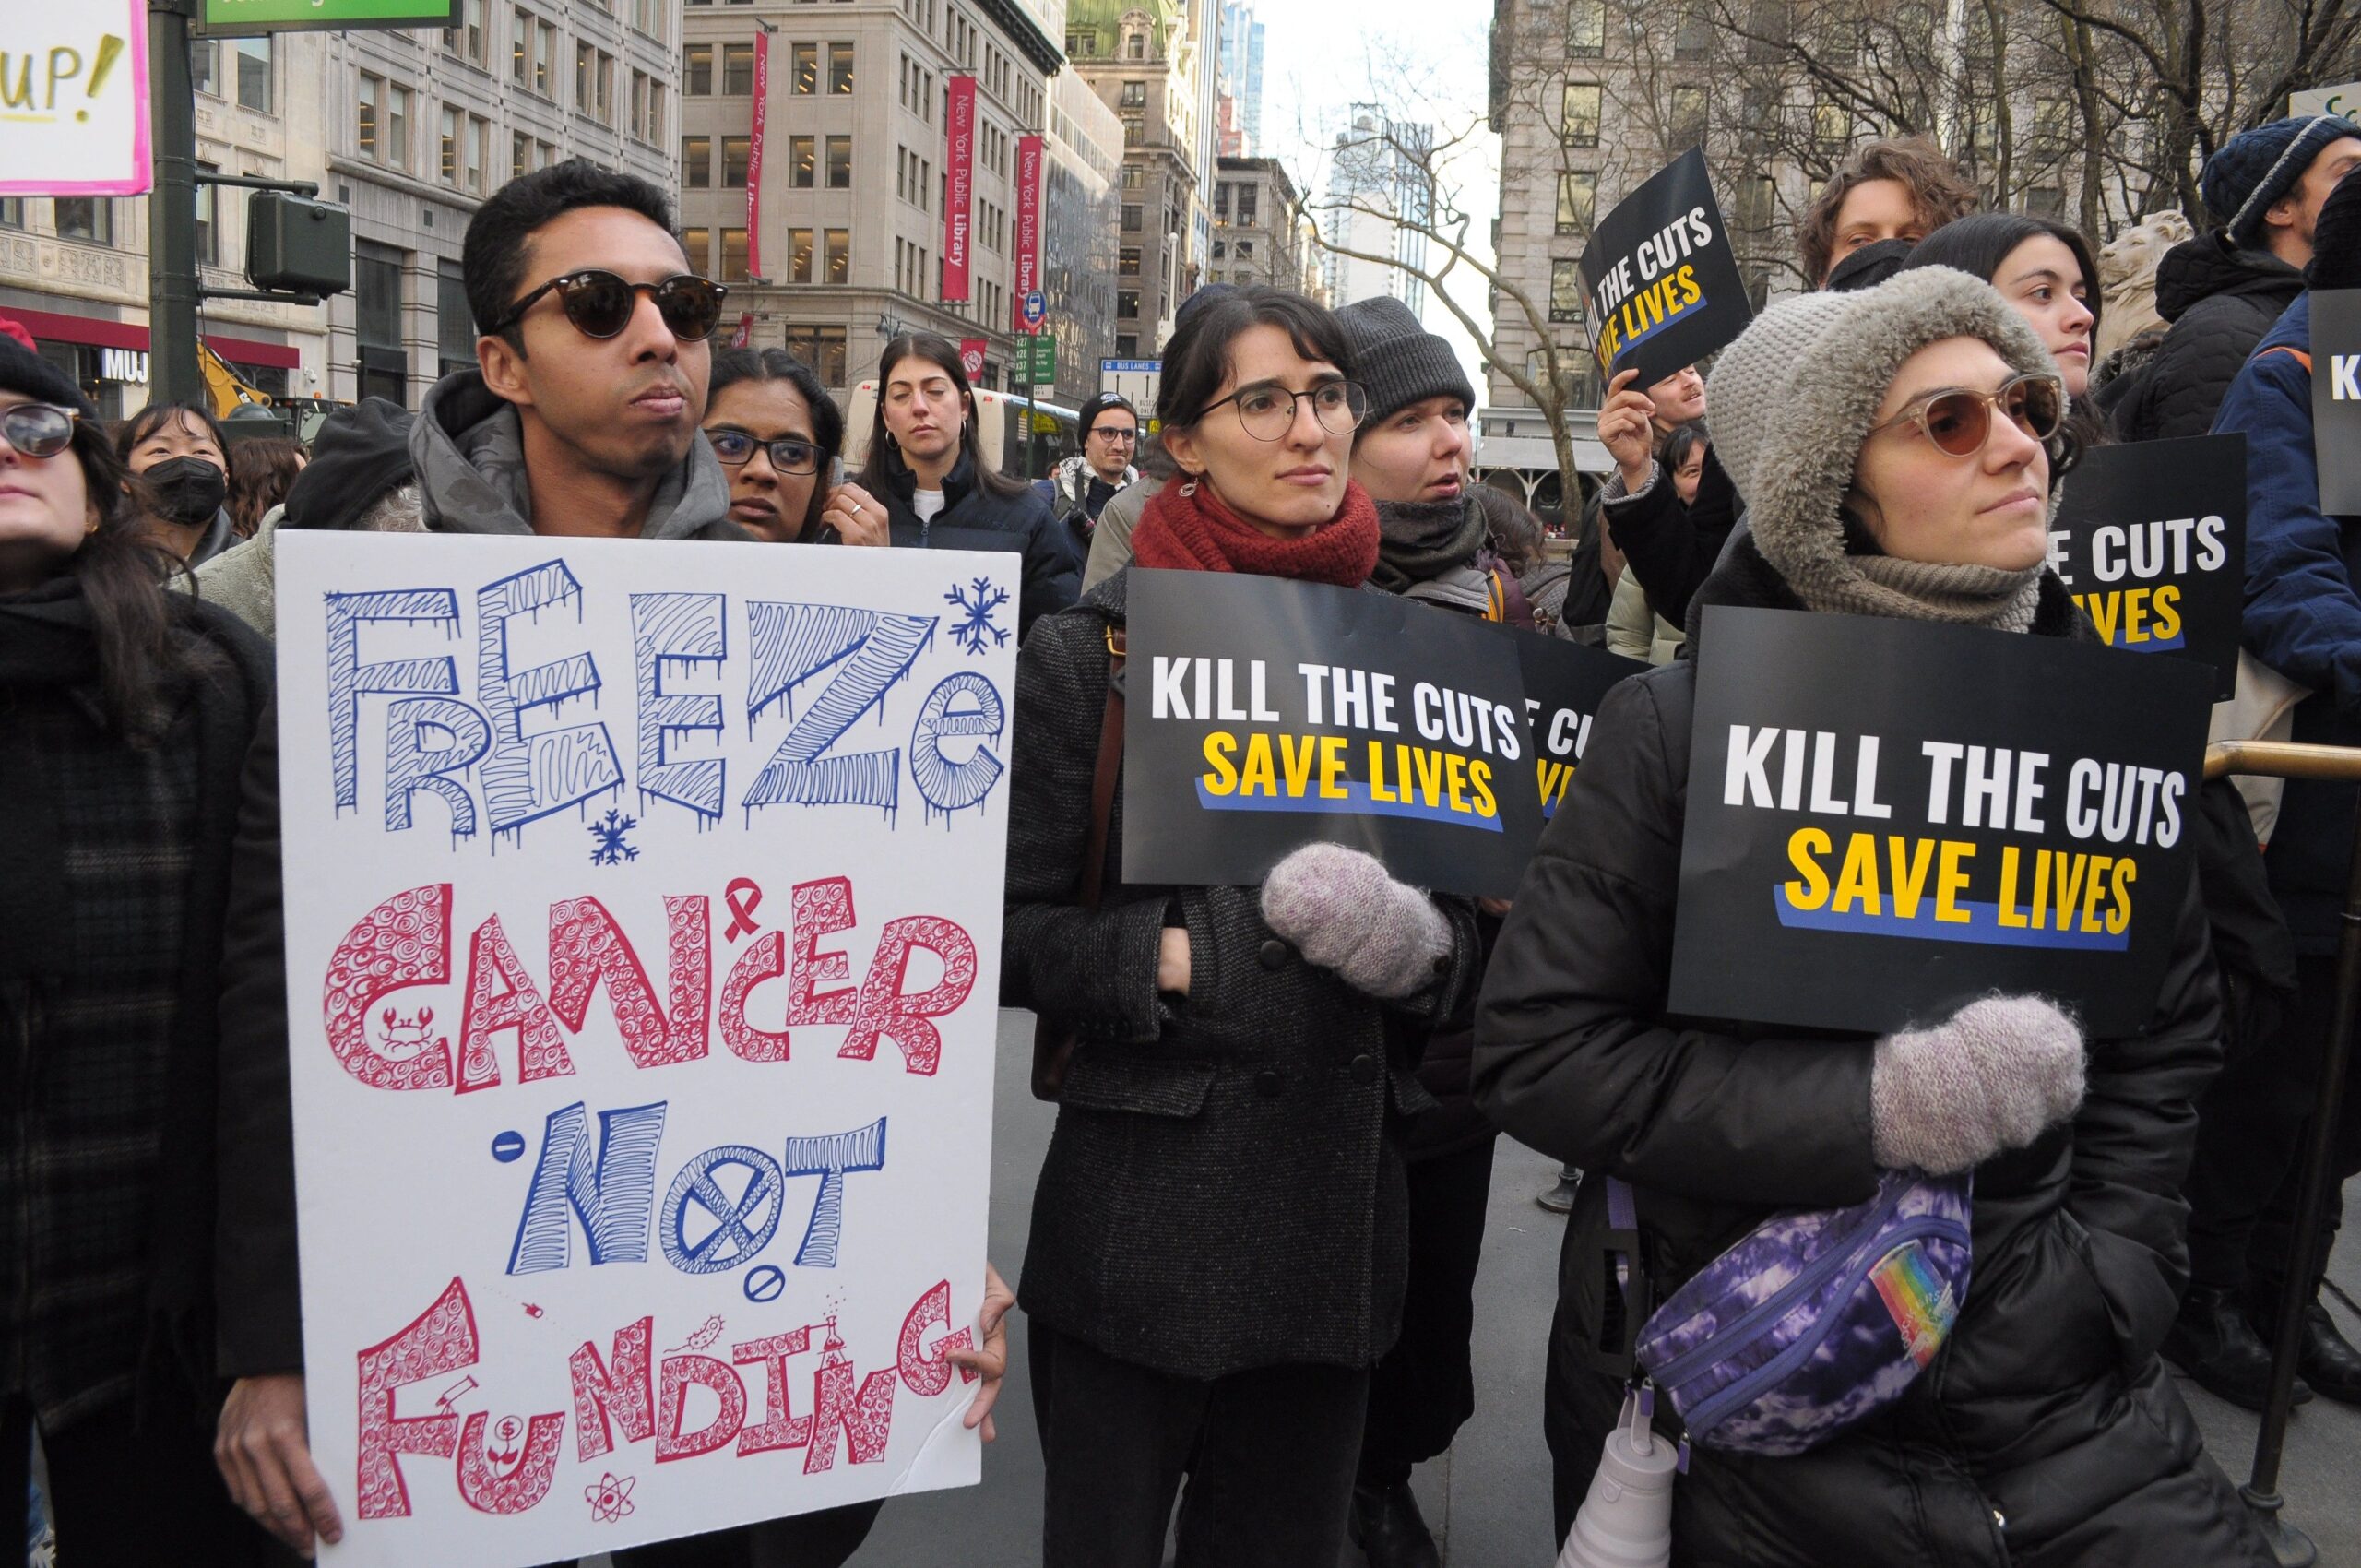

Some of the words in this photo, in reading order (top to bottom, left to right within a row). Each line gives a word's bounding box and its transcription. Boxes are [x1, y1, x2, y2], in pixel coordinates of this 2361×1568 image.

[756, 95, 765, 126] York
[955, 95, 969, 127] New
[749, 132, 763, 176] Public
[955, 132, 968, 162] York
[1024, 151, 1036, 179] New
[954, 168, 967, 208] Public
[1023, 183, 1035, 209] York
[949, 213, 967, 268] Library
[1021, 214, 1034, 249] Public
[1018, 254, 1033, 300] Library
[1597, 255, 1635, 317] THE
[1636, 206, 1713, 281] CUTS
[1622, 264, 1702, 341] LIVES
[1117, 362, 1129, 370] BUS
[1130, 362, 1149, 370] LANES
[2331, 354, 2361, 400] K
[2092, 515, 2226, 582] CUTS
[2071, 585, 2181, 646] VES
[1152, 656, 1280, 722] KILL
[1298, 662, 1399, 734] THE
[1413, 682, 1521, 761] CUTS
[1203, 731, 1349, 799] SAVE
[1368, 740, 1498, 818] LIVES
[1723, 724, 1892, 819] KILL
[1921, 741, 2050, 834] THE
[2065, 757, 2185, 849] CUTS
[1784, 827, 1975, 924] SAVE
[1997, 846, 2138, 936] LIVES
[324, 876, 978, 1095] CANCER
[505, 1100, 887, 1276] NOT
[357, 1276, 979, 1520] FUNDING
